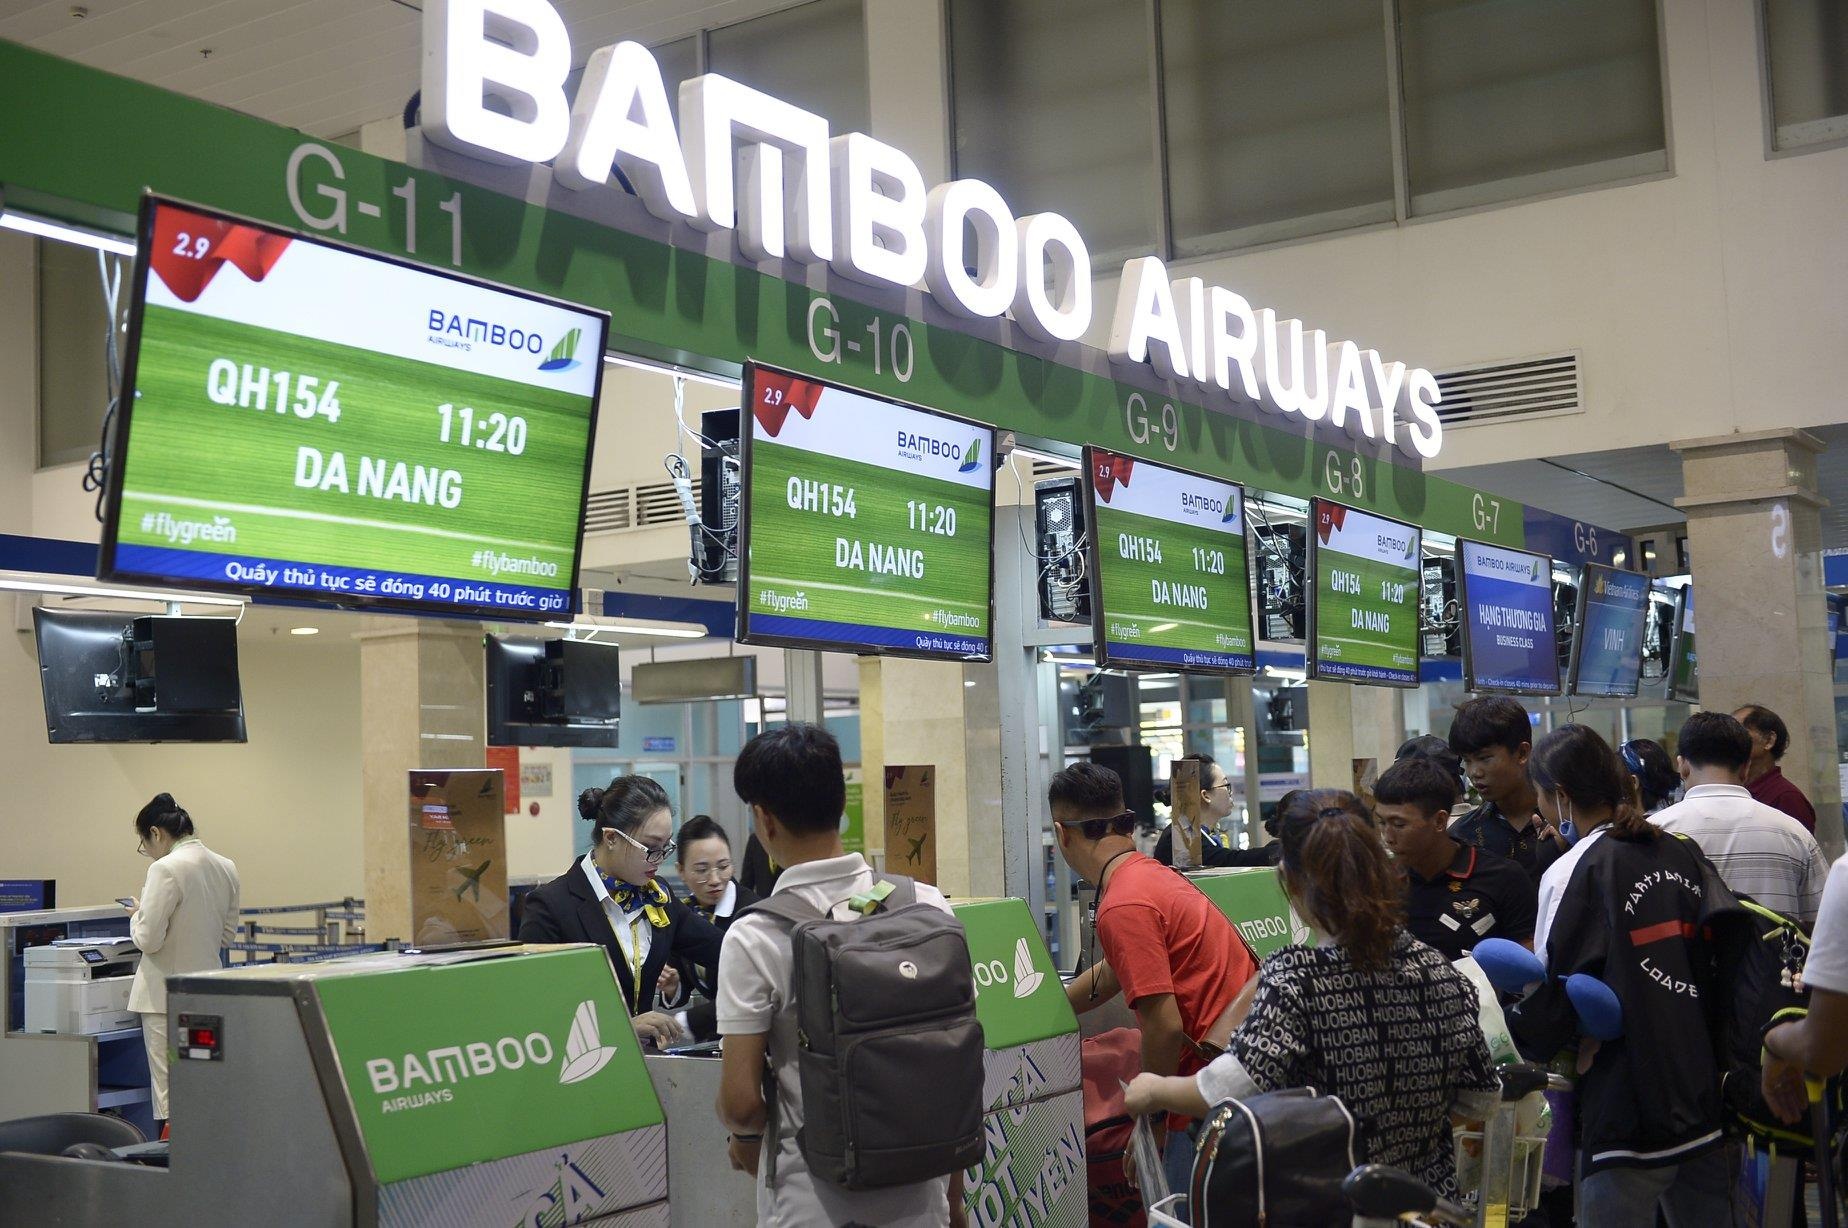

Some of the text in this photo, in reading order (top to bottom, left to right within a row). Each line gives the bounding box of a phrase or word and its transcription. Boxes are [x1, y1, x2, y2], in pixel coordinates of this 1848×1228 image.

[285, 140, 463, 266] G-11
[424, 0, 1443, 459] BAMBOO AIRWAYS
[172, 231, 210, 260] 2.9
[427, 335, 471, 352] AIRWAYS
[428, 309, 543, 354] BAMBOO
[807, 297, 914, 383] G-10
[206, 359, 527, 456] QH154 11:20
[764, 387, 783, 405] 2.9
[1125, 392, 1178, 452] G-9
[897, 430, 961, 461] BAMBOO
[898, 450, 923, 462] AIRWAYS
[294, 446, 463, 510] DA NANG
[1099, 464, 1110, 479] 2.9
[1325, 449, 1364, 498] G-8
[786, 476, 957, 537] QH154 11:20
[1181, 492, 1223, 514] BAMBOO
[1472, 493, 1500, 534] G-7
[140, 513, 236, 544] #flygreen
[1377, 534, 1406, 552] BAMBOO
[1574, 522, 1598, 556] G-6
[471, 550, 558, 578] #flybamboo
[835, 537, 925, 579] DA NANG
[1118, 533, 1225, 575] QH154 11:20
[1477, 556, 1531, 575] BAMBOO AIRWAYS
[225, 560, 563, 611] Quầy thủ tục sẽ đóng 40 phút trước giờ
[759, 590, 808, 611] #flygreen
[1151, 579, 1208, 610] DA NANG
[1331, 569, 1404, 604] QH154 11:20
[932, 608, 980, 629] #flybamboo
[1351, 608, 1390, 633] DA NANG
[1479, 603, 1501, 630] HẠNG
[1533, 612, 1547, 632] GIA
[1496, 634, 1534, 649] BUSINESS CLASS
[1604, 628, 1625, 651] VINH
[1624, 870, 1661, 915] PARTY
[1640, 957, 1698, 998] LOADE
[1320, 1026, 1378, 1048] HUOBAN
[1387, 1021, 1438, 1041] HUOBAN
[366, 1032, 553, 1094] BAMBOO
[1323, 1043, 1380, 1067] HUOBAN
[1384, 1039, 1432, 1058] HUOBAN
[381, 1088, 454, 1114] AIRWAYS
